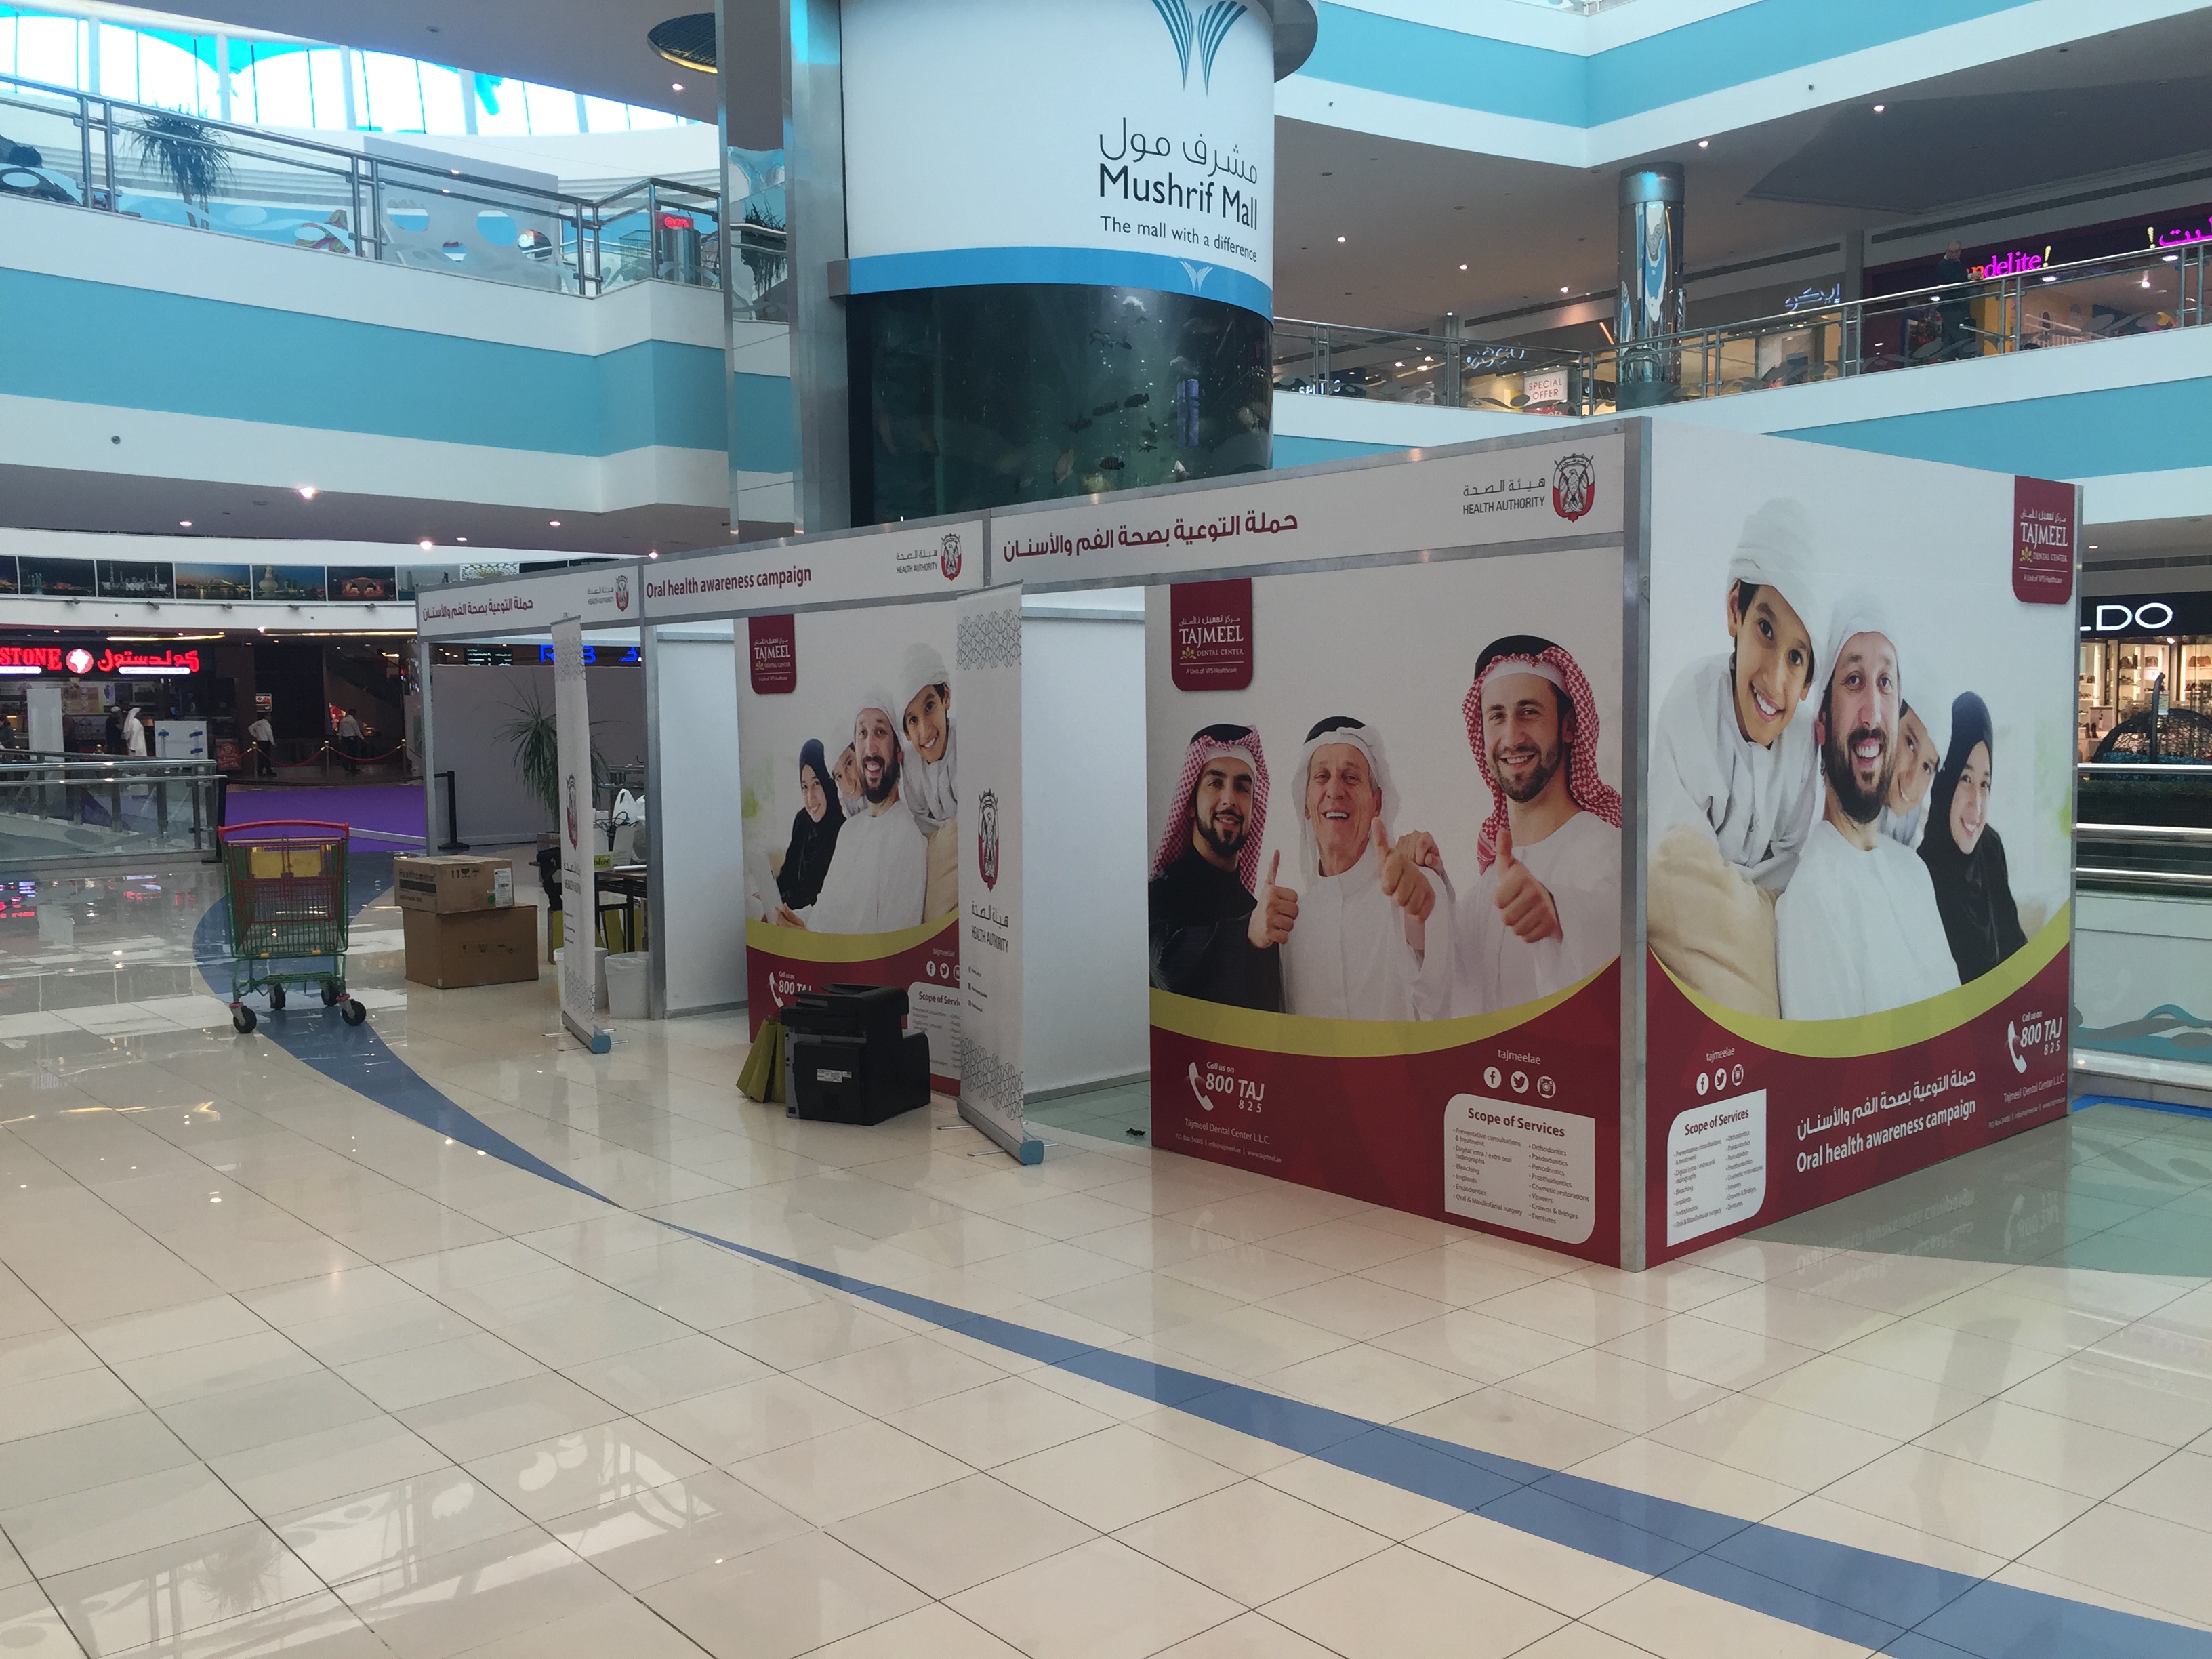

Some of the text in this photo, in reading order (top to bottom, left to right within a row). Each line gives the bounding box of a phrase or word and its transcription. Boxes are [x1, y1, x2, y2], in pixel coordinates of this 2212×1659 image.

[1099, 117, 1257, 184] مشرف مول
[1099, 163, 1257, 230] Mushrif Mall
[1099, 216, 1256, 262] The mall with a difference
[1529, 377, 1562, 391] SPECIAL
[1532, 388, 1559, 401] OFFER
[1463, 478, 1545, 497] هيئة الصحة
[1463, 496, 1545, 515] HEALTH AUTHORITY
[1174, 516, 1240, 546] التوعية
[1245, 510, 1298, 534] حملة
[1076, 529, 1114, 556] الفم
[1118, 525, 1170, 548] بصحة
[2020, 522, 2068, 550] TAJMEEL
[2033, 552, 2068, 562] DENTAL CENTER
[896, 562, 938, 574] HEALTH AUTHORITY
[646, 565, 811, 598] Oral health awareness campaign
[468, 601, 488, 616] بصحة
[489, 599, 512, 615] التوعية
[514, 596, 533, 610] حملة
[1179, 625, 1244, 649] TAJMEEL
[0, 647, 62, 670] STONE
[754, 645, 791, 662] TAJMEEL
[971, 924, 986, 944] HEALTH
[779, 980, 794, 994] 800
[919, 991, 960, 1006] Scope of Servi
[2020, 1017, 2063, 1048] 800 TAJ
[1498, 1049, 1541, 1065] tajmeelae
[1706, 1047, 1735, 1063] tajmeelae
[1206, 1061, 1218, 1070] Call
[1206, 1073, 1265, 1101] 800 TAJ
[1950, 1069, 1976, 1087] حملة
[1913, 1074, 1949, 1102] التوعية
[2003, 1080, 2053, 1103] Tajmeel Dental Center
[1880, 1090, 1912, 1110] بصحة
[1852, 1096, 1878, 1124] الفم
[1185, 1118, 1208, 1130] Tajmeel
[1210, 1124, 1230, 1136] Dental
[1231, 1128, 1252, 1141] Center
[1468, 1107, 1565, 1137] Scope of Services
[1685, 1109, 1749, 1136] Scope of Services
[1460, 1136, 1485, 1147] treatment
[1797, 1099, 1976, 1172] Oral health awareness campaign
[1456, 1145, 1471, 1154] Digital
[1456, 1153, 1485, 1164] radiographs
[1532, 1143, 1567, 1156] Orthodontics
[1532, 1153, 1568, 1166] Paedodontics
[1456, 1163, 1480, 1175] Bleaching
[1532, 1163, 1565, 1176] Periodontics
[1456, 1174, 1477, 1183] Implants
[1532, 1173, 1572, 1187] Prosthodontics
[1456, 1183, 1487, 1196] Endodontics
[1532, 1183, 1589, 1202] Cosmetic restorations
[1532, 1193, 1553, 1203] Veneers
[1456, 1193, 1466, 1202] Oral
[1503, 1206, 1523, 1216] surgery
[1532, 1203, 1552, 1213] Crowns
[1558, 1209, 1578, 1219] Bridges
[1532, 1213, 1556, 1224] Dentures
